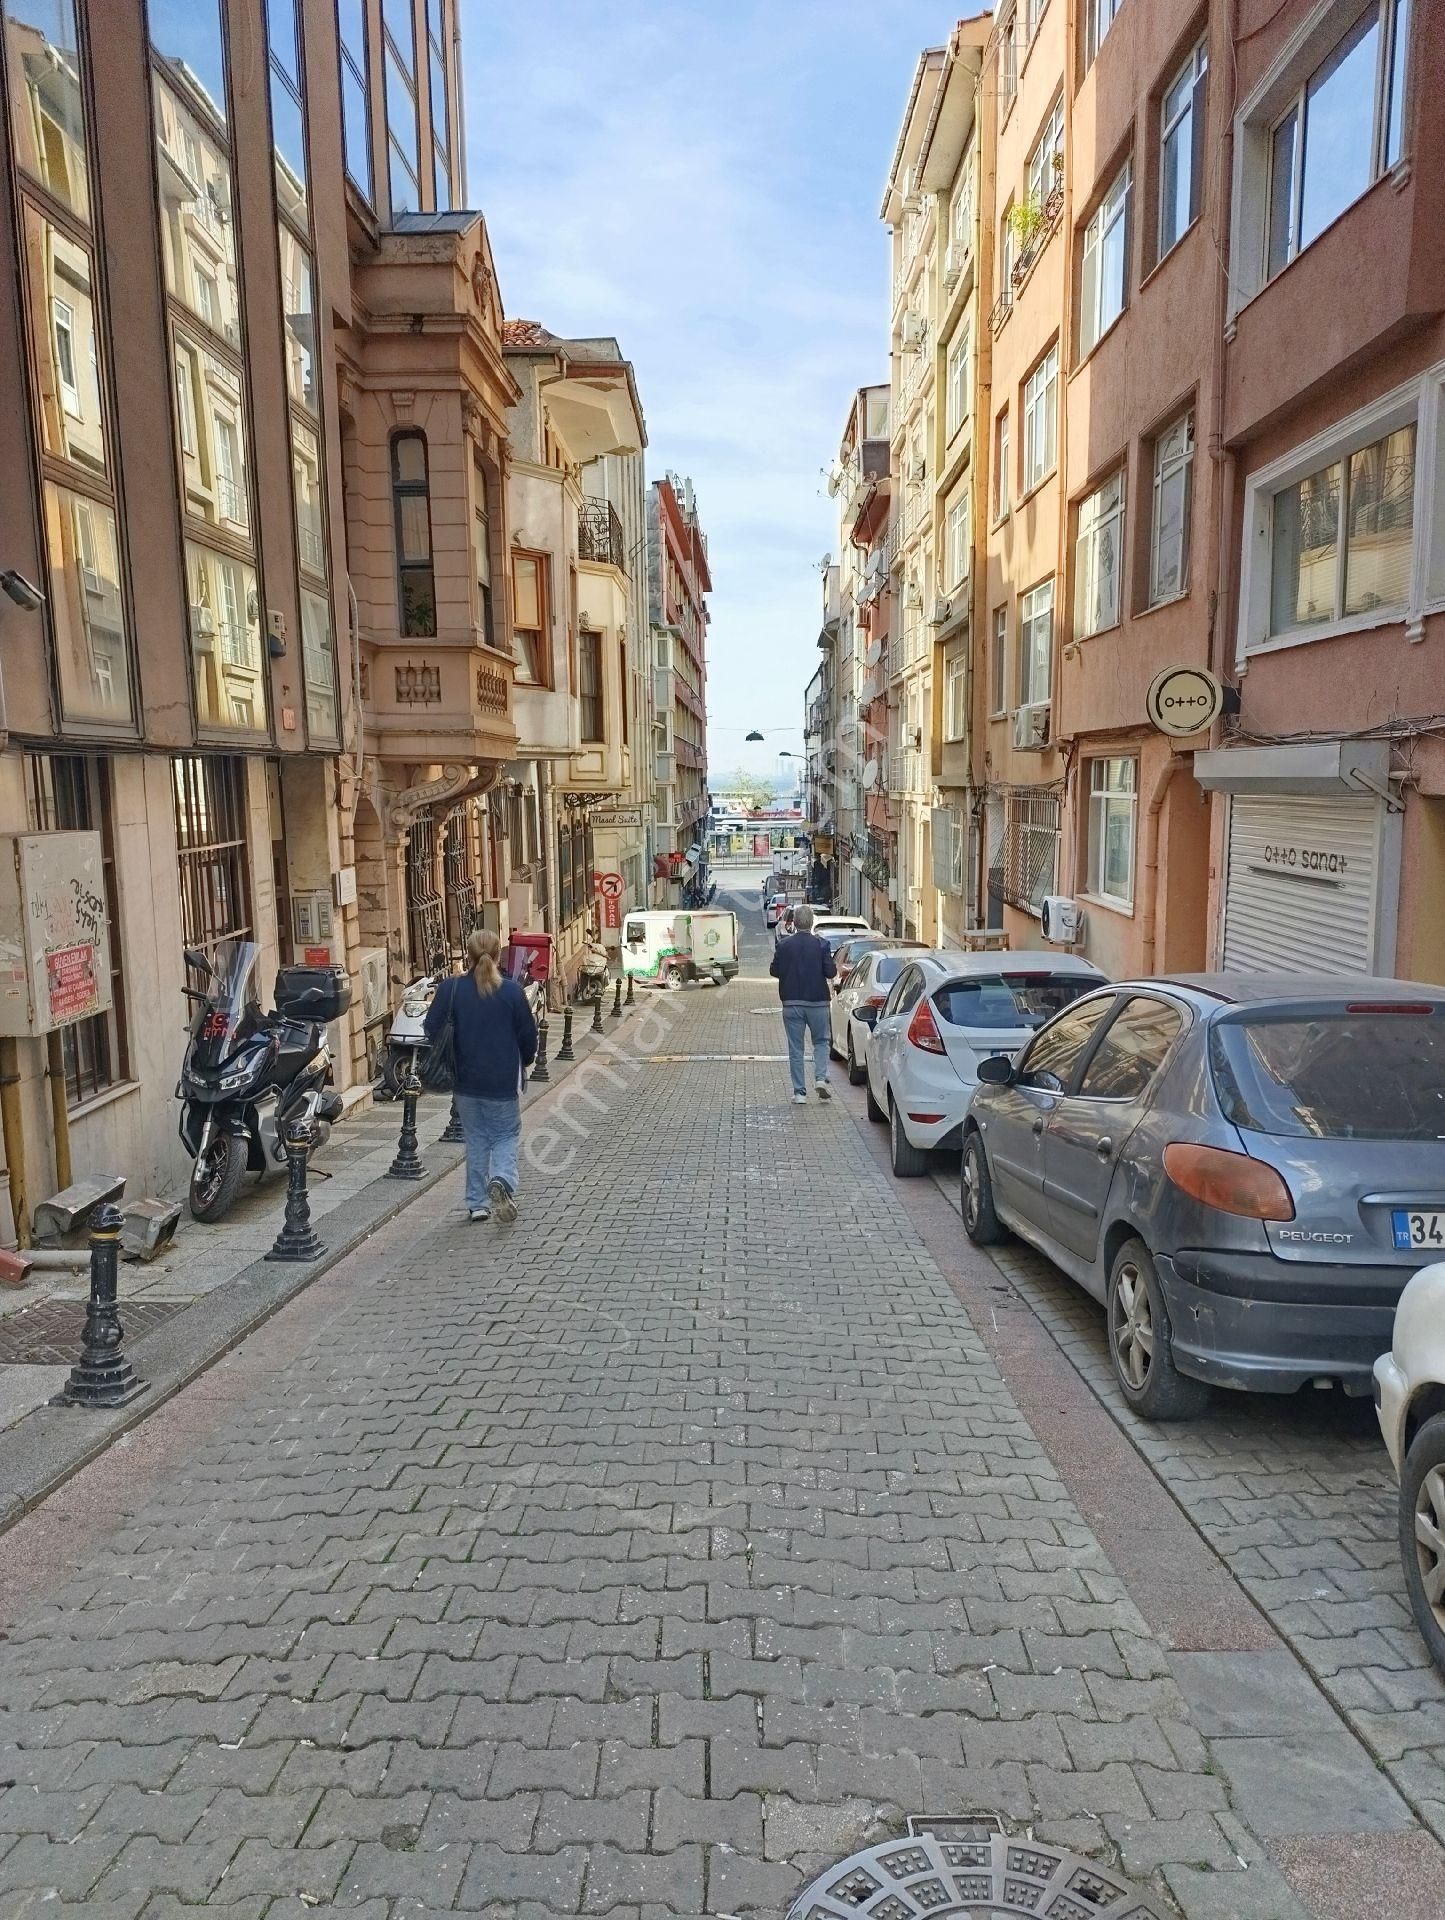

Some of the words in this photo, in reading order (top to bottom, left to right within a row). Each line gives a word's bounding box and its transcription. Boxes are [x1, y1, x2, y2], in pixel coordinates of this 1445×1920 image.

[1164, 695, 1208, 708] otto
[1264, 845, 1297, 866] otto
[1301, 849, 1348, 874] sanat
[1396, 1231, 1409, 1241] TR
[1410, 1215, 1444, 1244] 34
[1279, 1230, 1354, 1244] PEUGEOT
